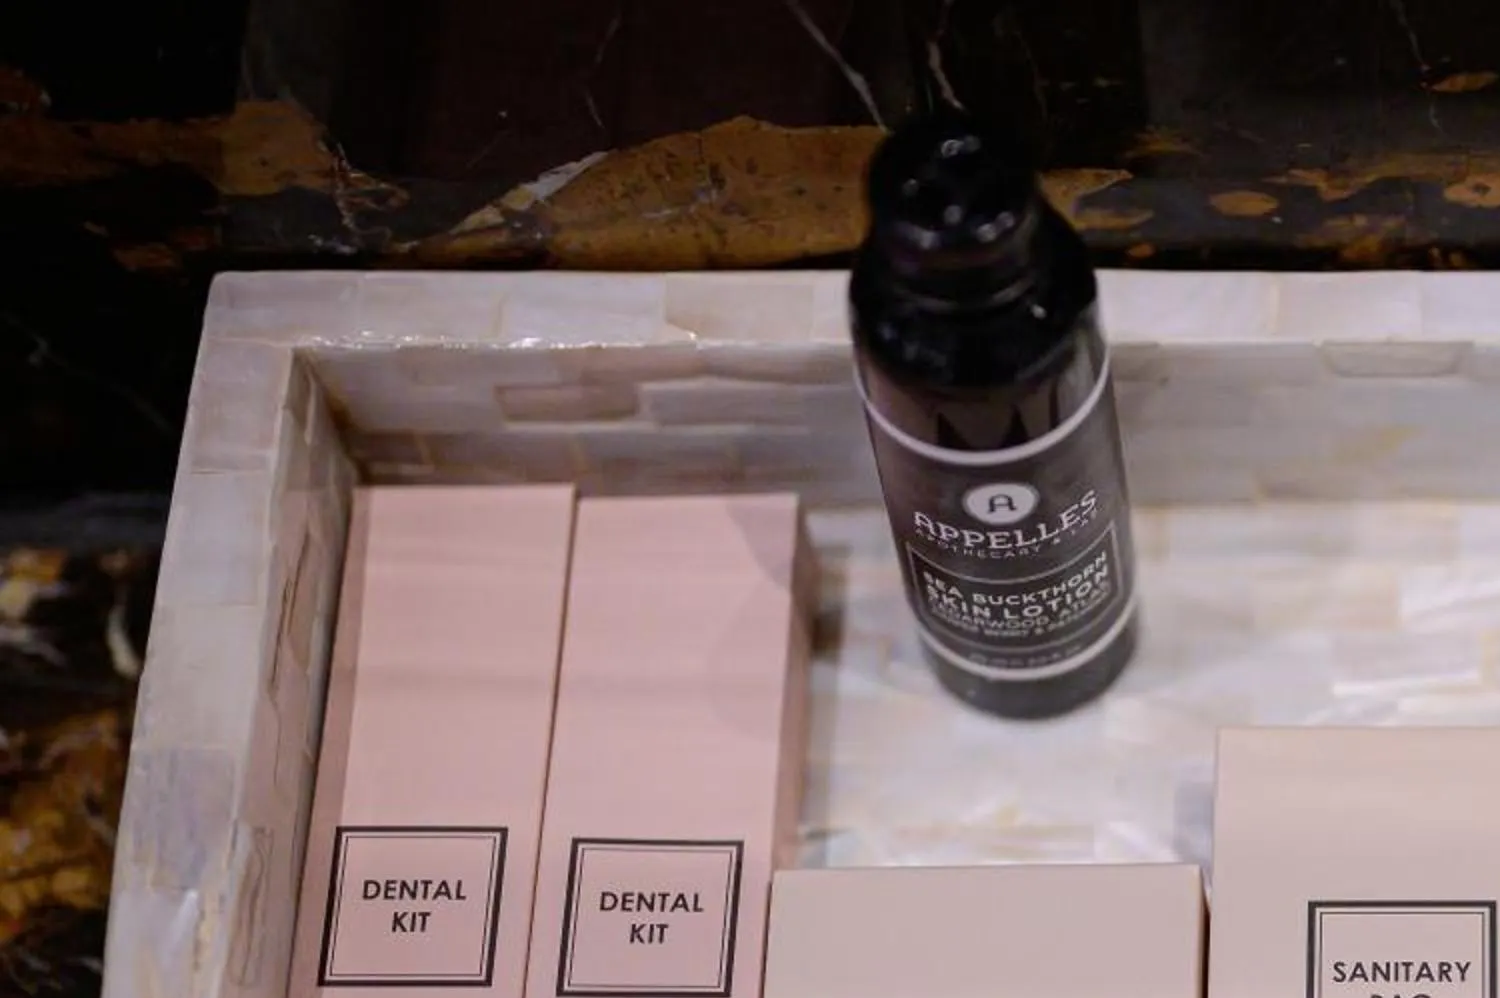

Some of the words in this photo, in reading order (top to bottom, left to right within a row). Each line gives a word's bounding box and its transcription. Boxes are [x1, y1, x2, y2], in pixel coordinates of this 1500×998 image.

[987, 493, 1018, 513] A
[913, 489, 1098, 550] APPELLES
[923, 571, 964, 600] SEA
[971, 551, 1107, 606] BUCKTHORN
[926, 585, 992, 620] SKIN
[1002, 563, 1109, 620] LOTION
[361, 879, 467, 901] DENTAL
[599, 891, 705, 913] DENTAL
[390, 910, 432, 934] KIT
[628, 922, 670, 945] KIT
[1332, 961, 1472, 984] SANITARY
